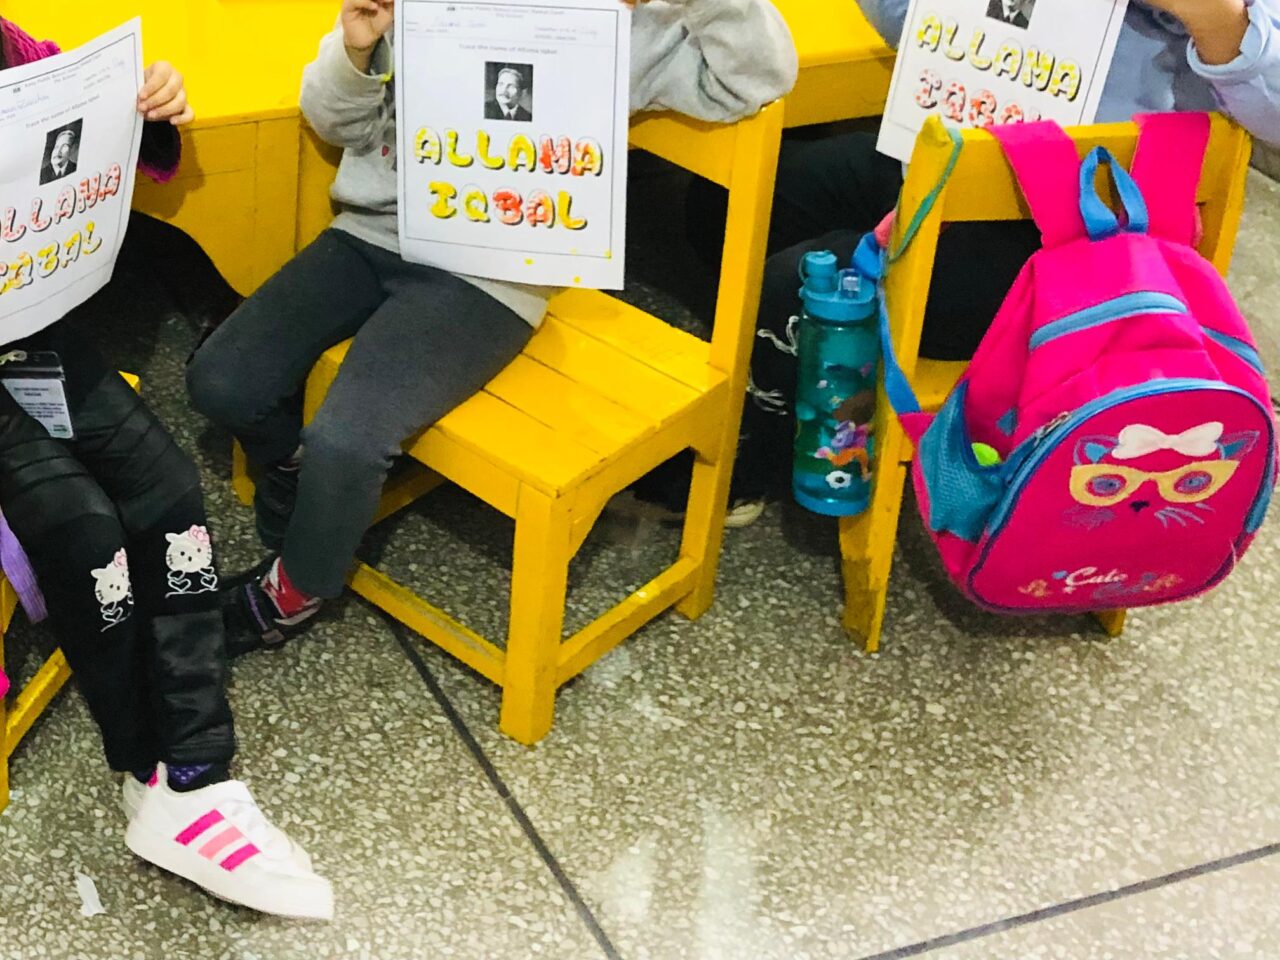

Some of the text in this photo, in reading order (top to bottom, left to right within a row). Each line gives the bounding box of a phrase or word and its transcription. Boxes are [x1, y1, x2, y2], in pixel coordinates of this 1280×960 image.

[917, 10, 1083, 103] ALLAMA
[413, 125, 603, 178] ALLAMA
[427, 180, 588, 231] IQBAL
